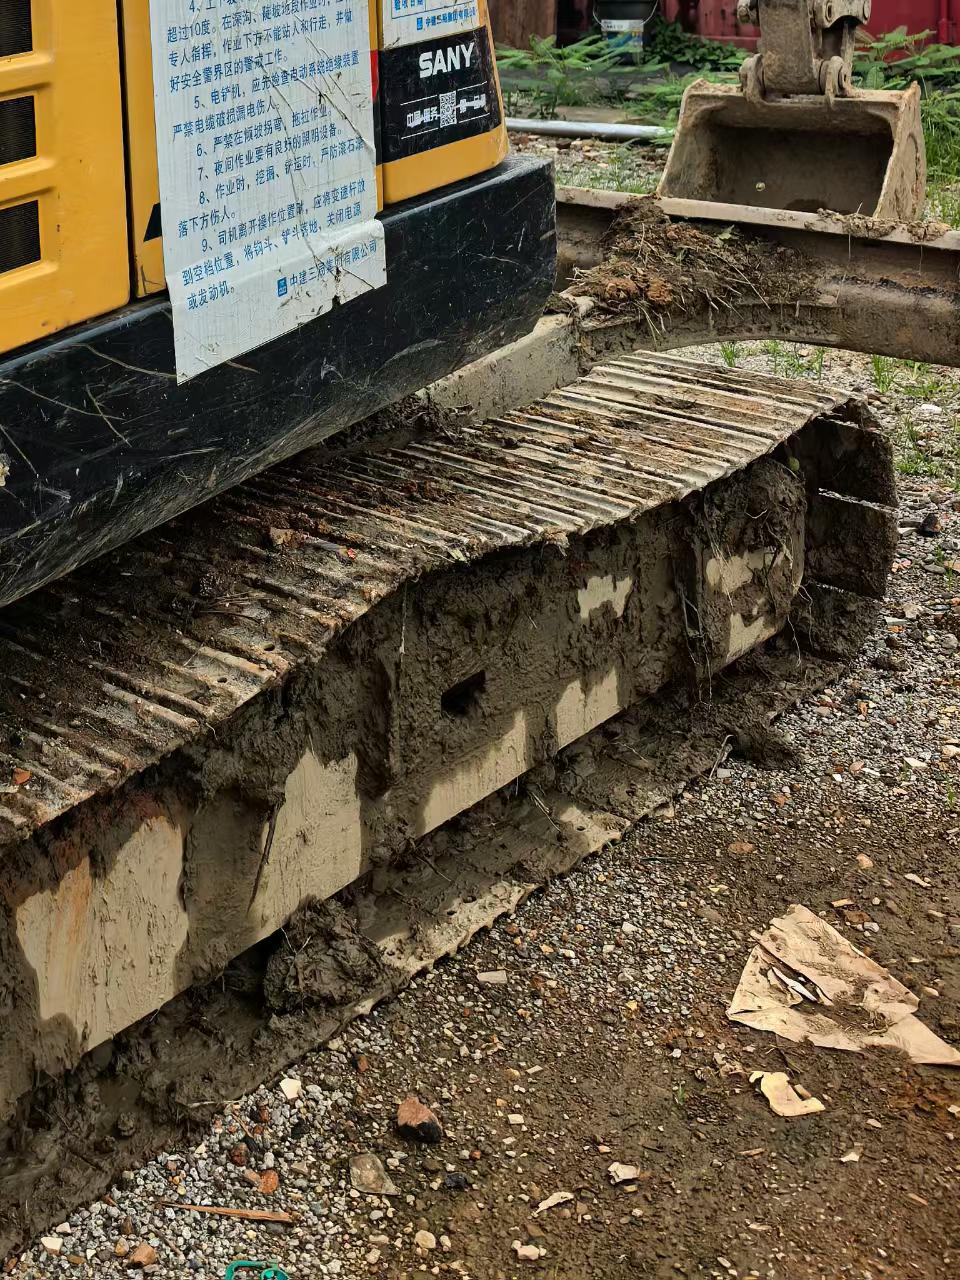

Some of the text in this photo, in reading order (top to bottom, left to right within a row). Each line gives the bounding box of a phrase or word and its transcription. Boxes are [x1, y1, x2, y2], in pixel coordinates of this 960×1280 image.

[419, 42, 475, 79] SANY
[178, 206, 237, 238] 落下方伤人。
